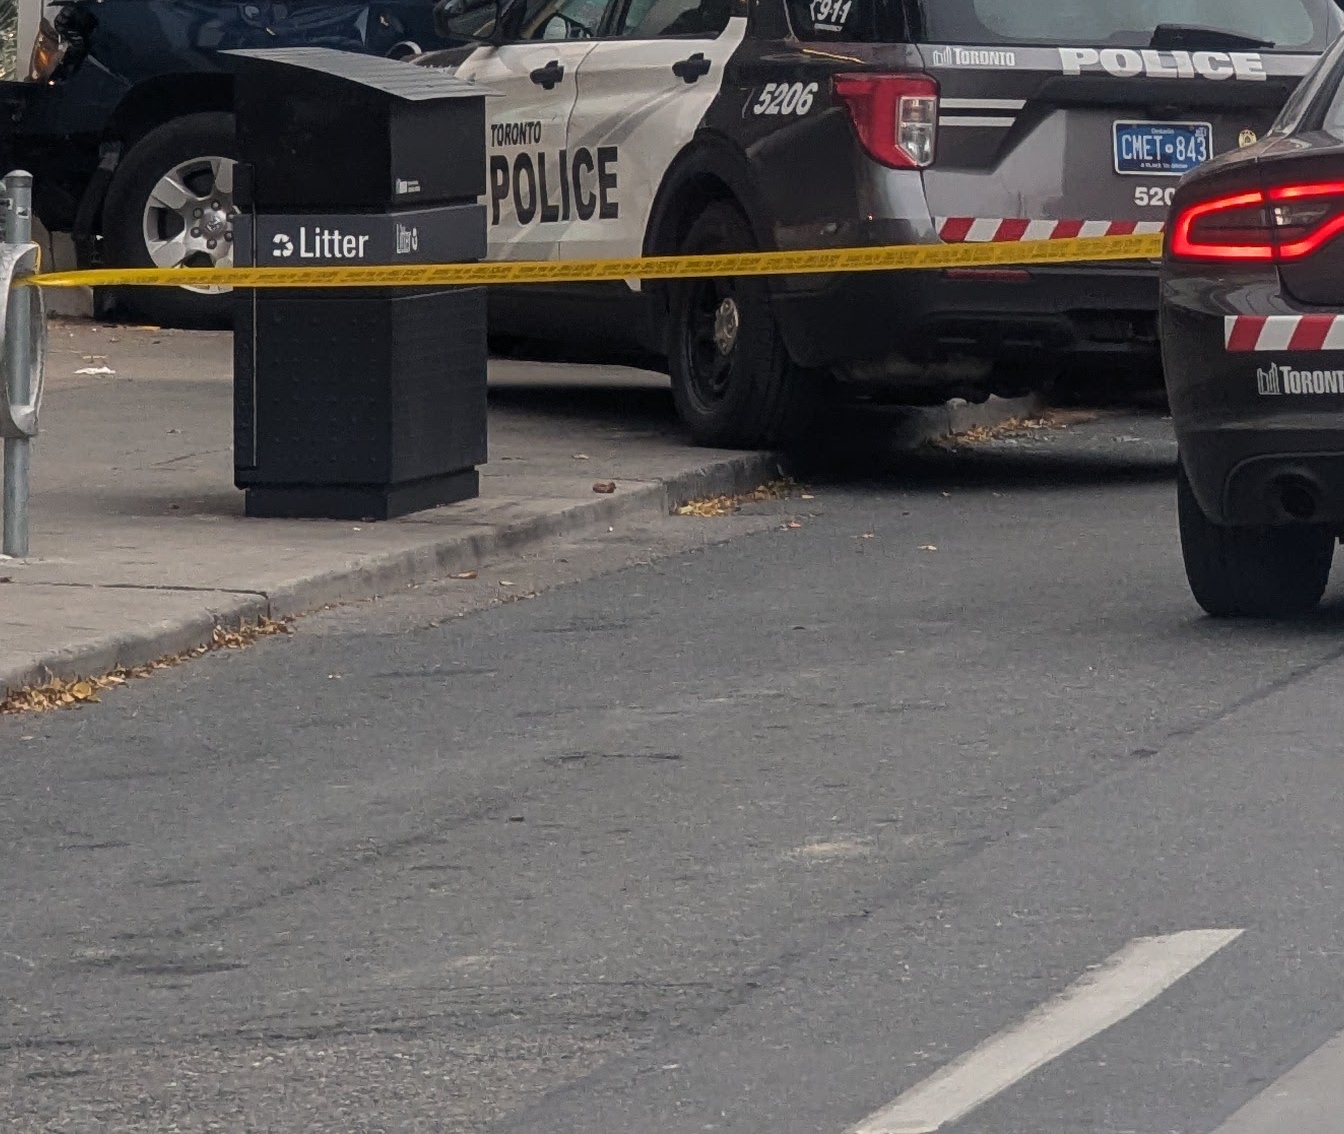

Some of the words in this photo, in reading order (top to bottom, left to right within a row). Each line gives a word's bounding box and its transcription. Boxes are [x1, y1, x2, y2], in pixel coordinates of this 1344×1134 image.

[953, 48, 1016, 67] TORONTO
[1058, 47, 1267, 82] POLICE
[753, 82, 819, 116] 5206
[491, 120, 542, 147] TORONTO
[1121, 134, 1163, 161] CMET
[1175, 136, 1207, 162] 843
[490, 145, 618, 226] POLICE
[299, 226, 370, 258] Litter
